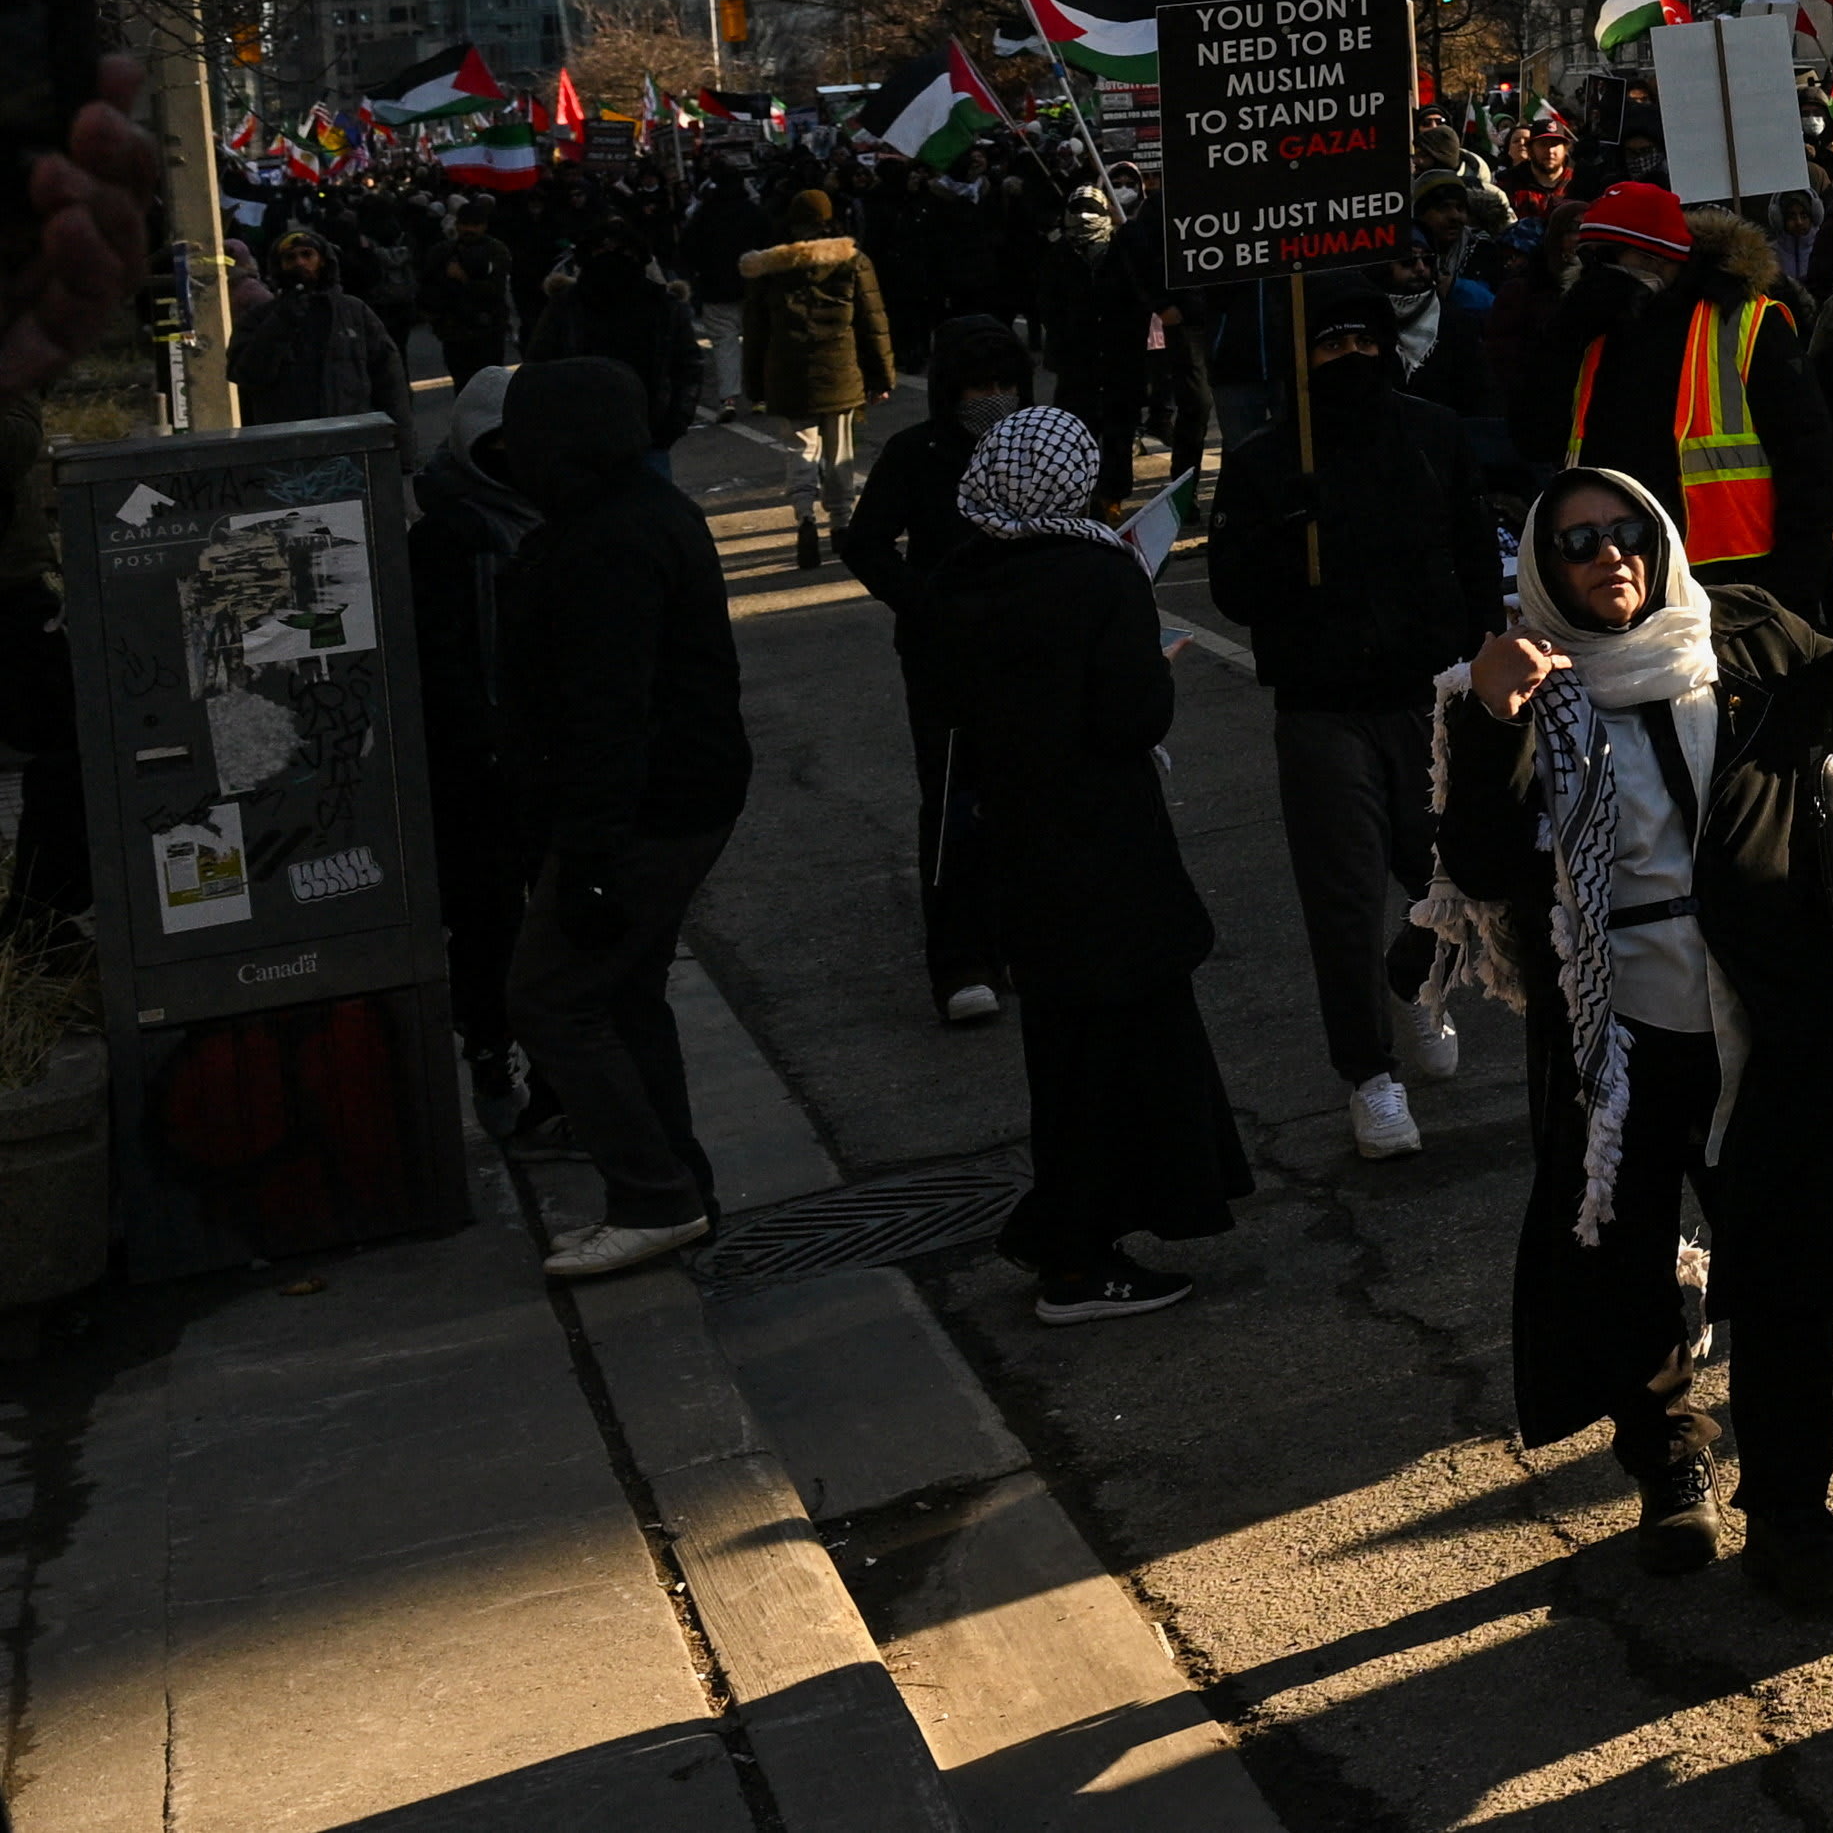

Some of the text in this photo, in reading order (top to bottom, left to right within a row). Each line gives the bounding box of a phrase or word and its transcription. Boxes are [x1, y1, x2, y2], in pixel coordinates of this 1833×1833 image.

[1195, 2, 1264, 33] YOU
[1196, 25, 1373, 67] NEED TO BE
[1226, 62, 1346, 98] MUSLIM
[1185, 91, 1386, 136] TO STAND UP
[1207, 126, 1379, 169] FOR GAZA!
[1173, 190, 1405, 241] YOU JUST NEED
[1182, 224, 1398, 274] TO BE HUMAN
[109, 521, 200, 543] CANADA
[113, 552, 167, 570] POST
[237, 952, 318, 985] Canada
